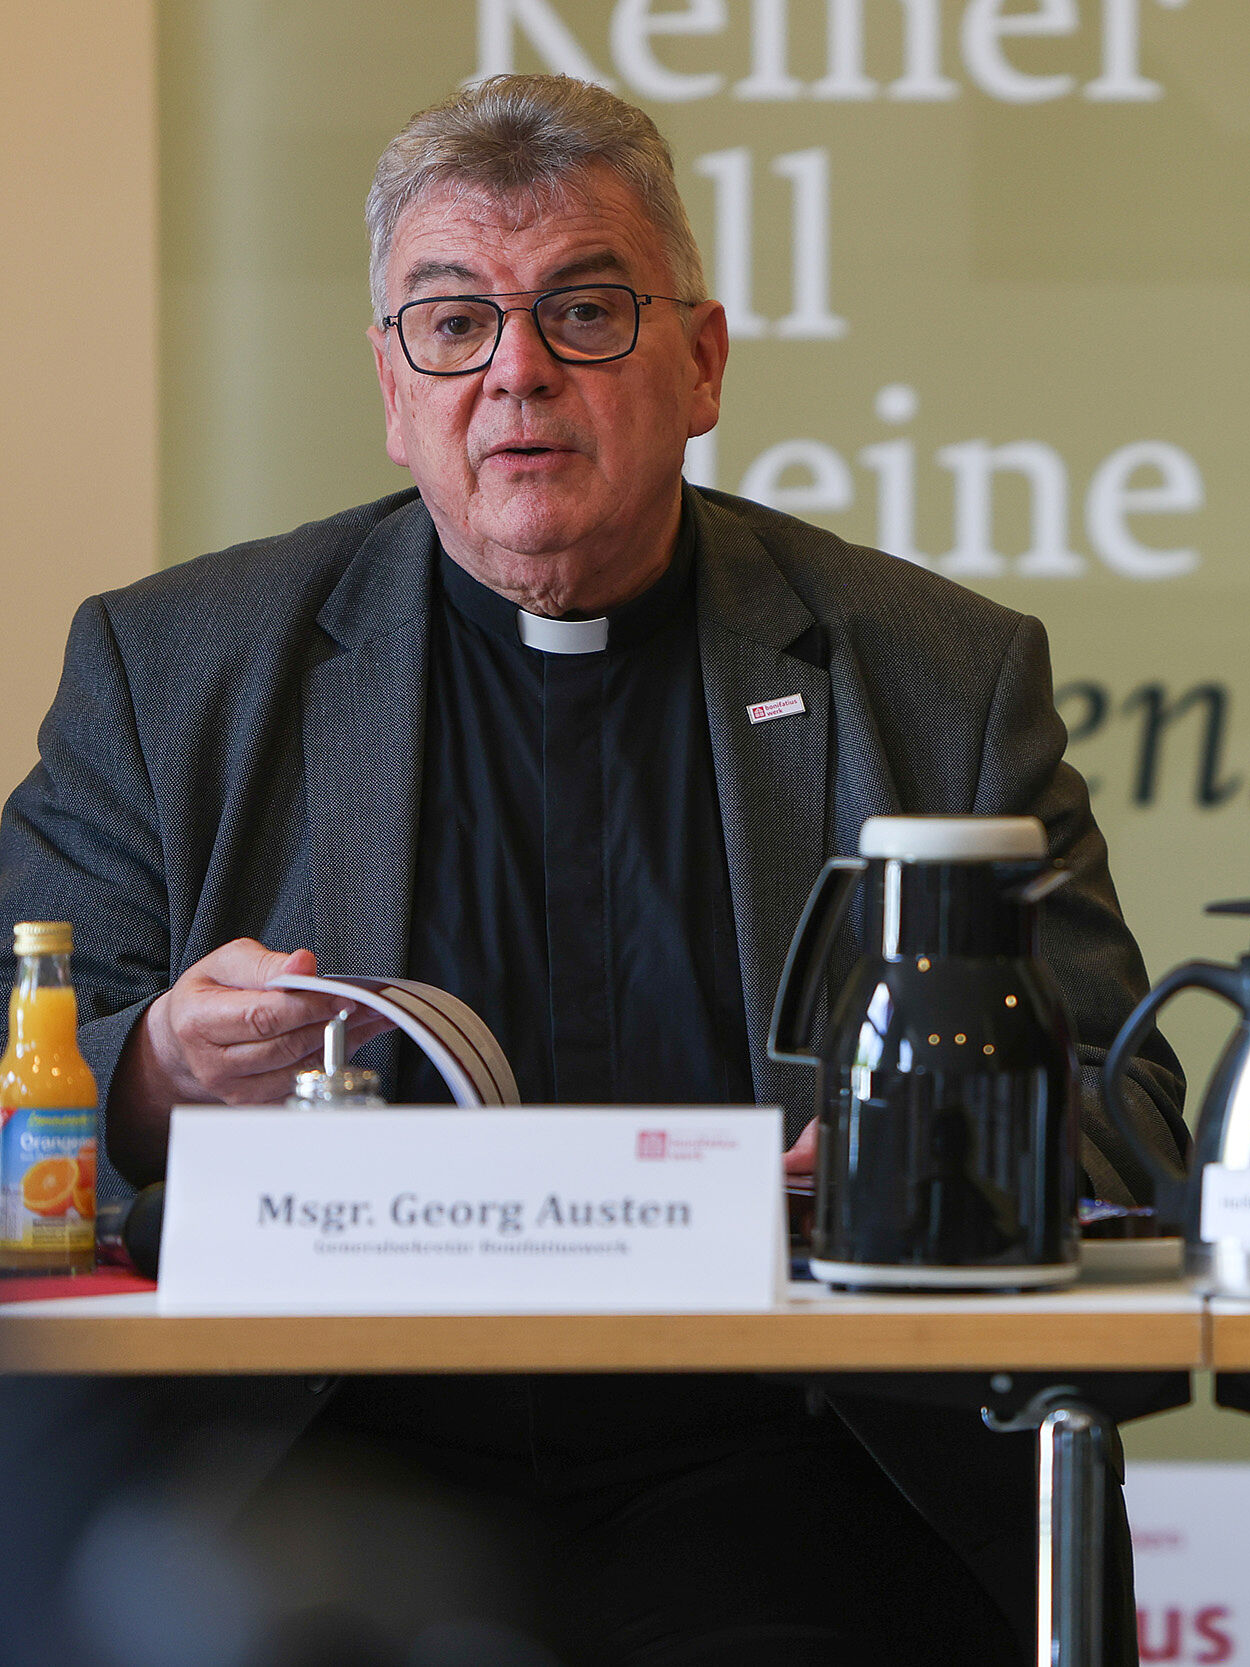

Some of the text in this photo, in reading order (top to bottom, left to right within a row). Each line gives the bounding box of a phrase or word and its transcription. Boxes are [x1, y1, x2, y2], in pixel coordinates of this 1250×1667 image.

[695, 146, 848, 341] ll
[765, 699, 798, 710] bonifatius
[767, 708, 782, 717] werk
[257, 1192, 692, 1235] Msgr. Georg Austen
